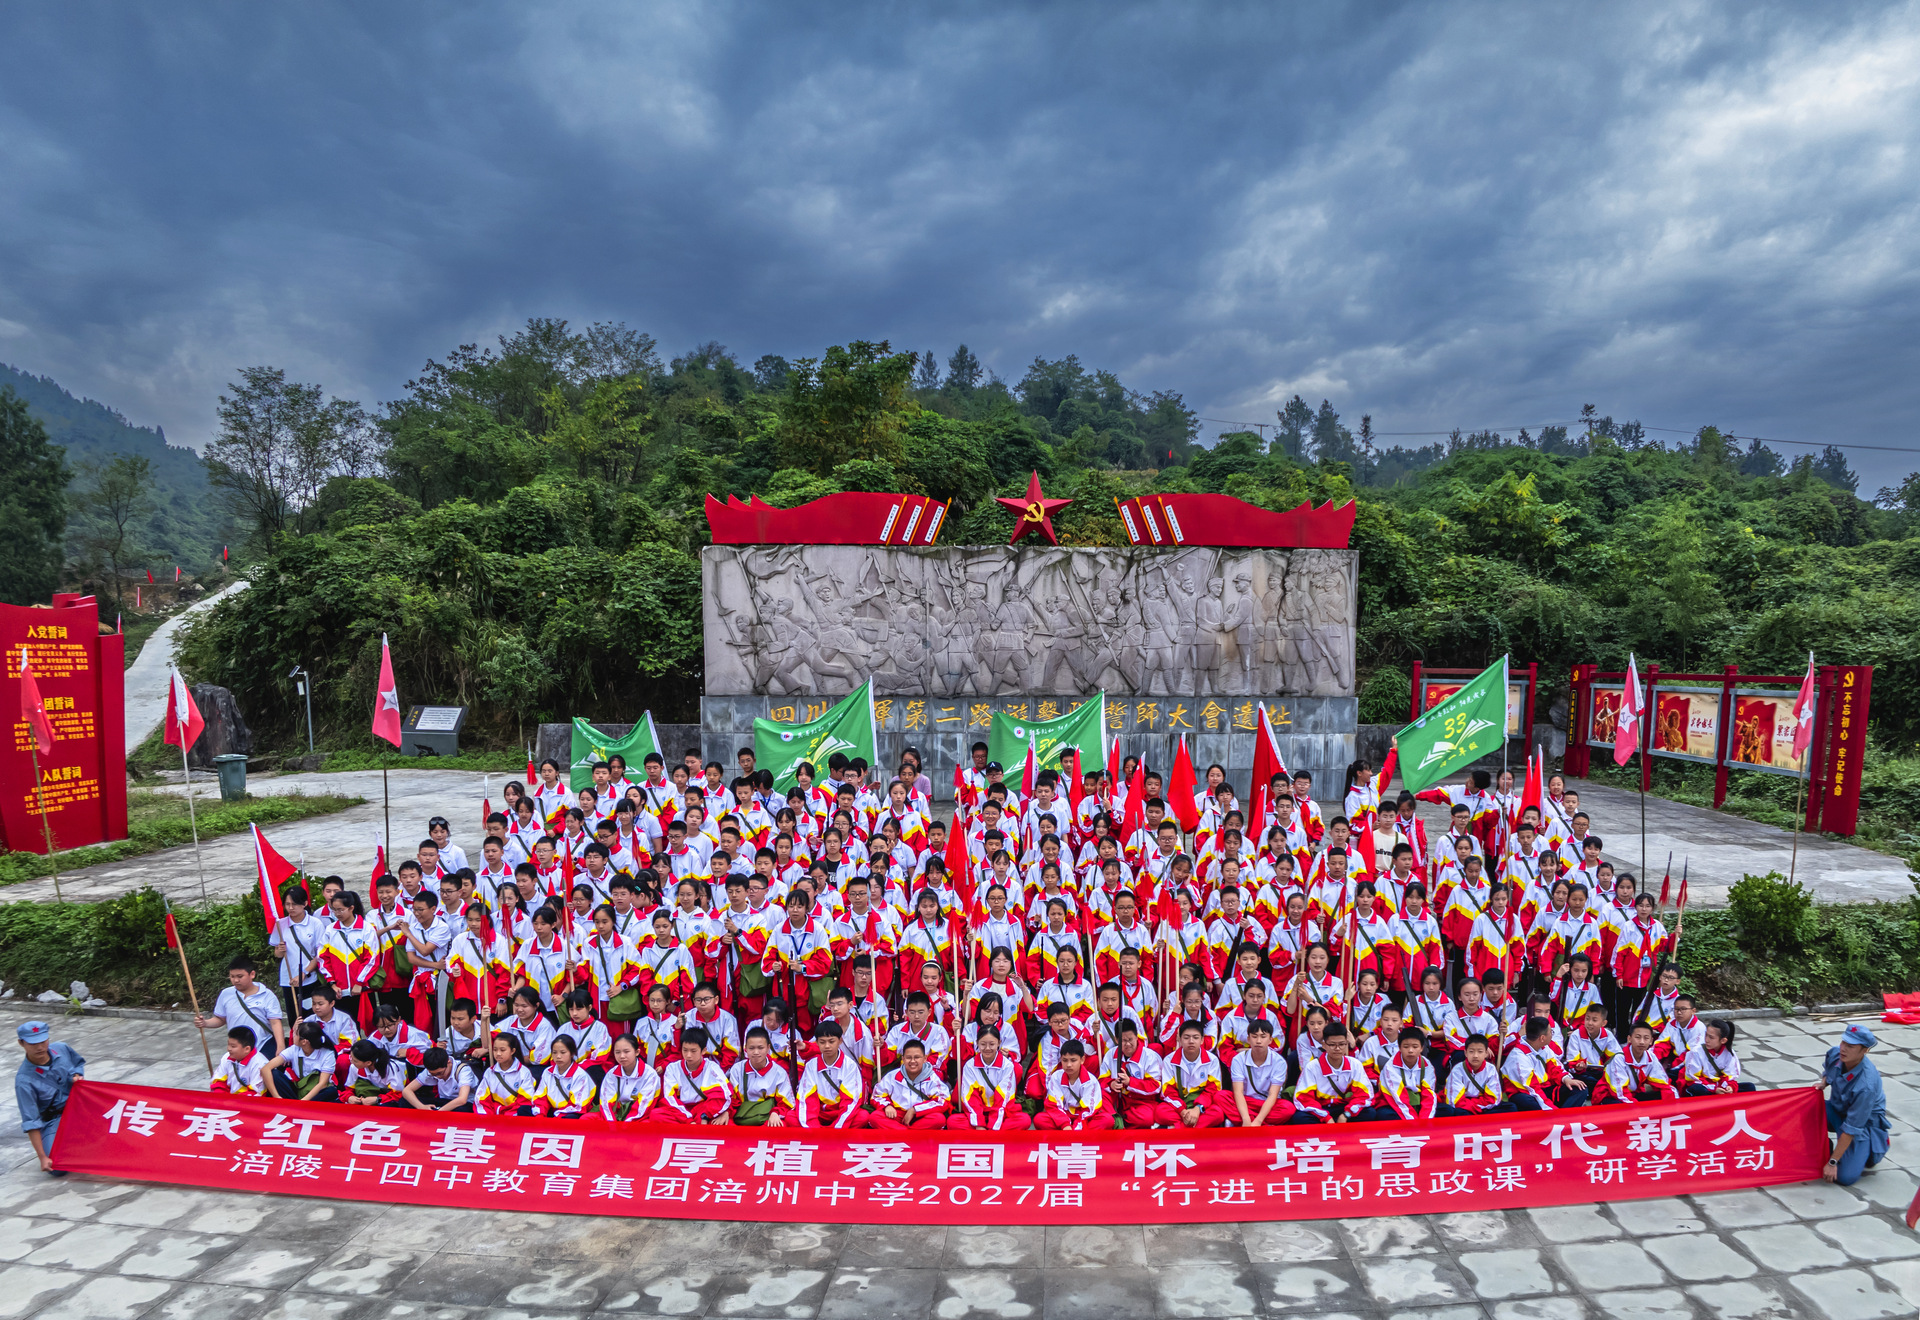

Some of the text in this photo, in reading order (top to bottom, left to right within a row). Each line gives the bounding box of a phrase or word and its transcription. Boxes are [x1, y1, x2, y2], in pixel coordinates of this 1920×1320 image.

[27, 625, 67, 639] 入党誓词
[44, 697, 74, 711] 团誓词
[771, 699, 1292, 731] 四川軍第二路游擊誓師大會遺址
[1444, 712, 1466, 739] 33
[1834, 691, 1853, 796] 不忘初心 牢记使命
[42, 766, 82, 783] 入队誓词
[103, 1100, 1773, 1179] 传承红色基因 厚植爱国情怀 培育时代新人
[1586, 1146, 1774, 1184] 研学活动
